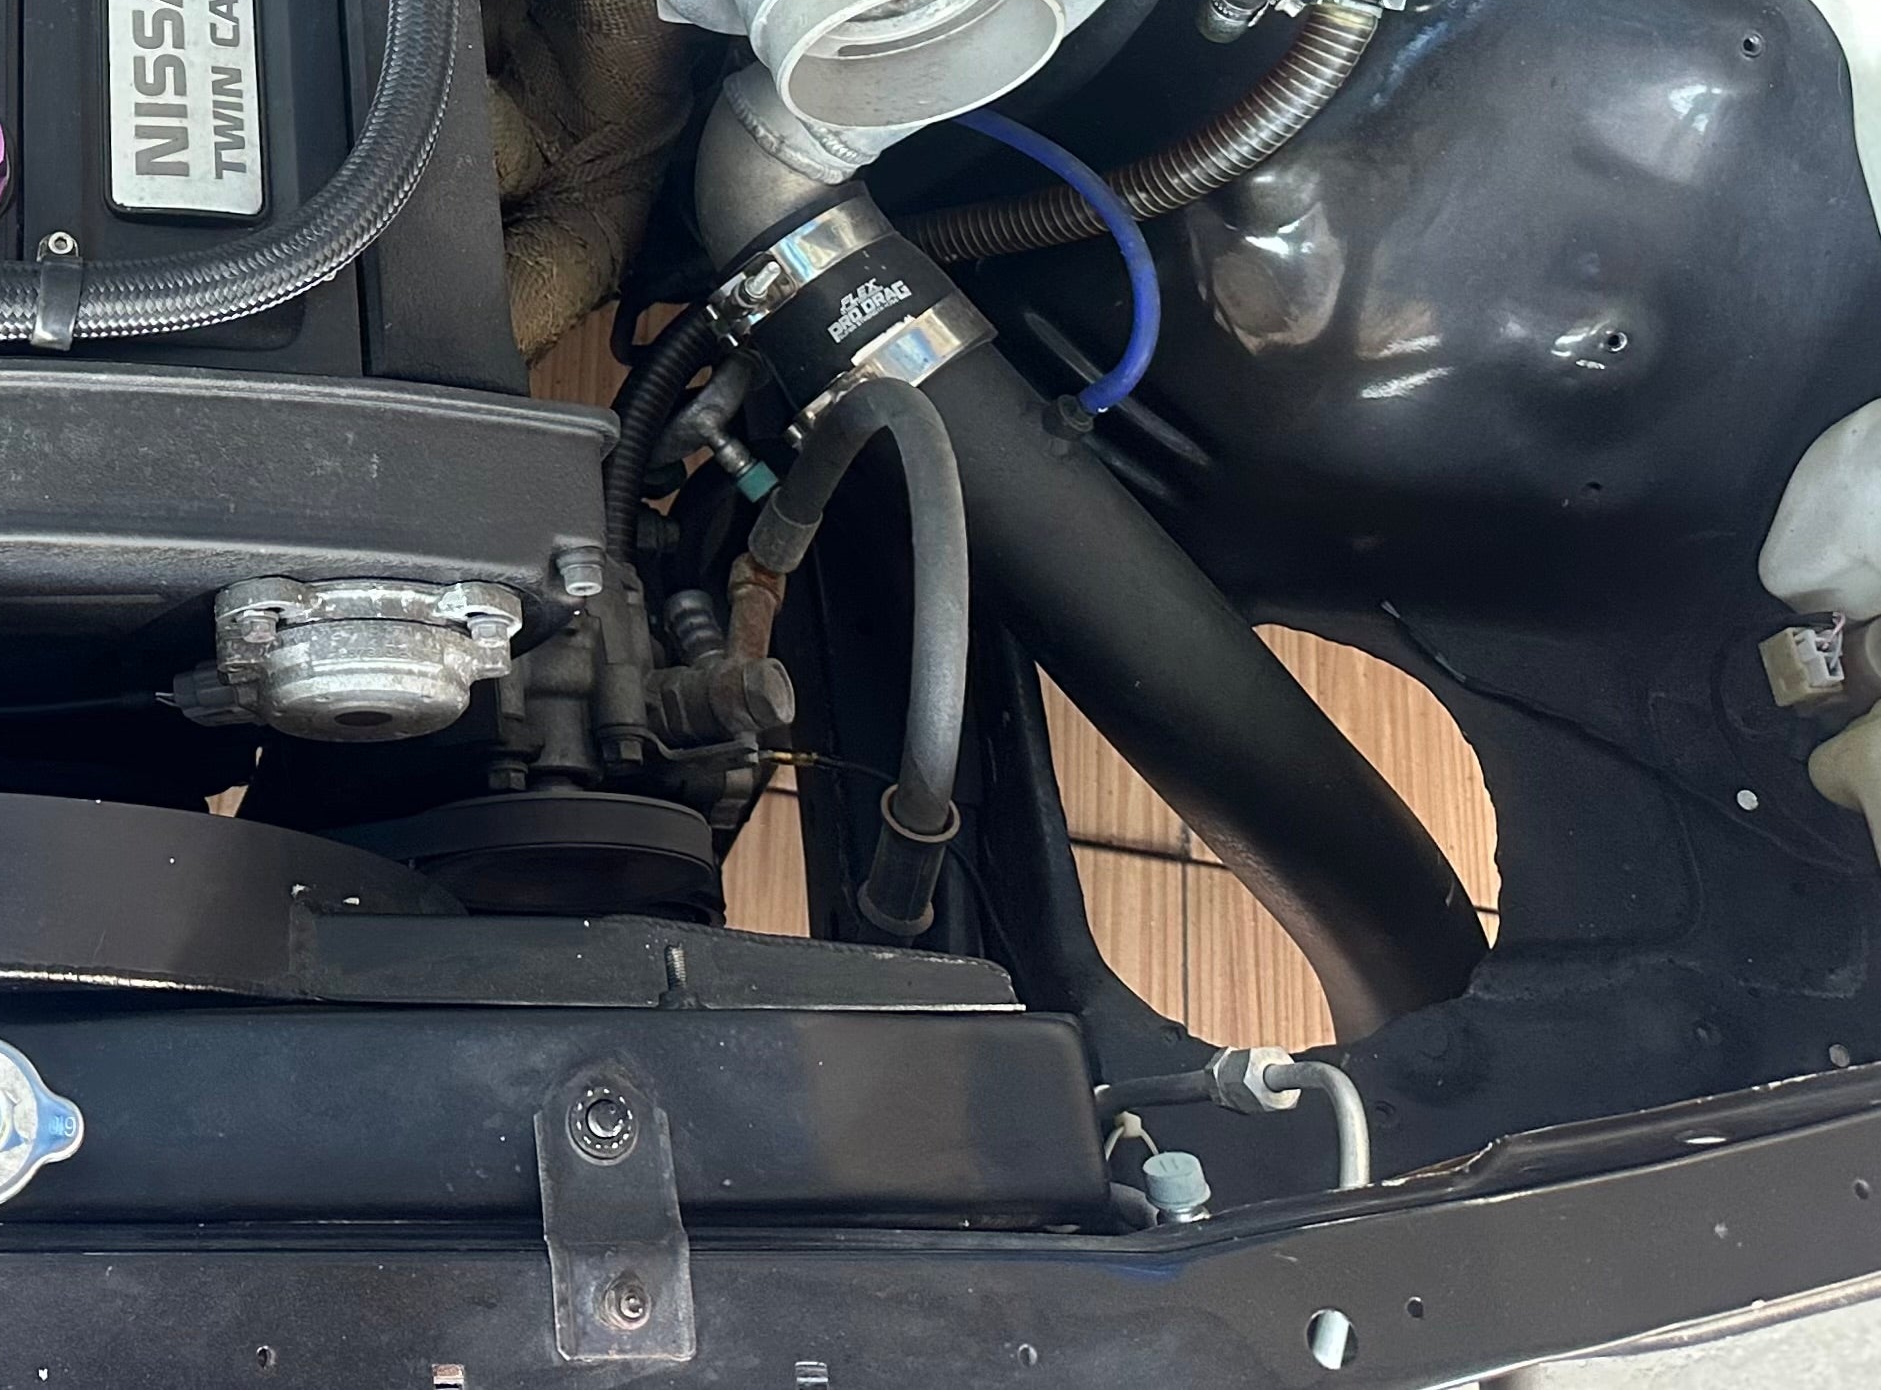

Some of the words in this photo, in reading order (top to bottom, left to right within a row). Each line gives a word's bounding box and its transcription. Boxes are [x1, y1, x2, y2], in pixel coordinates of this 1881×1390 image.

[210, 66, 247, 180] TWIN
[827, 307, 863, 343] PRO
[861, 279, 912, 314] DRAG
[840, 277, 884, 310] FLEX
